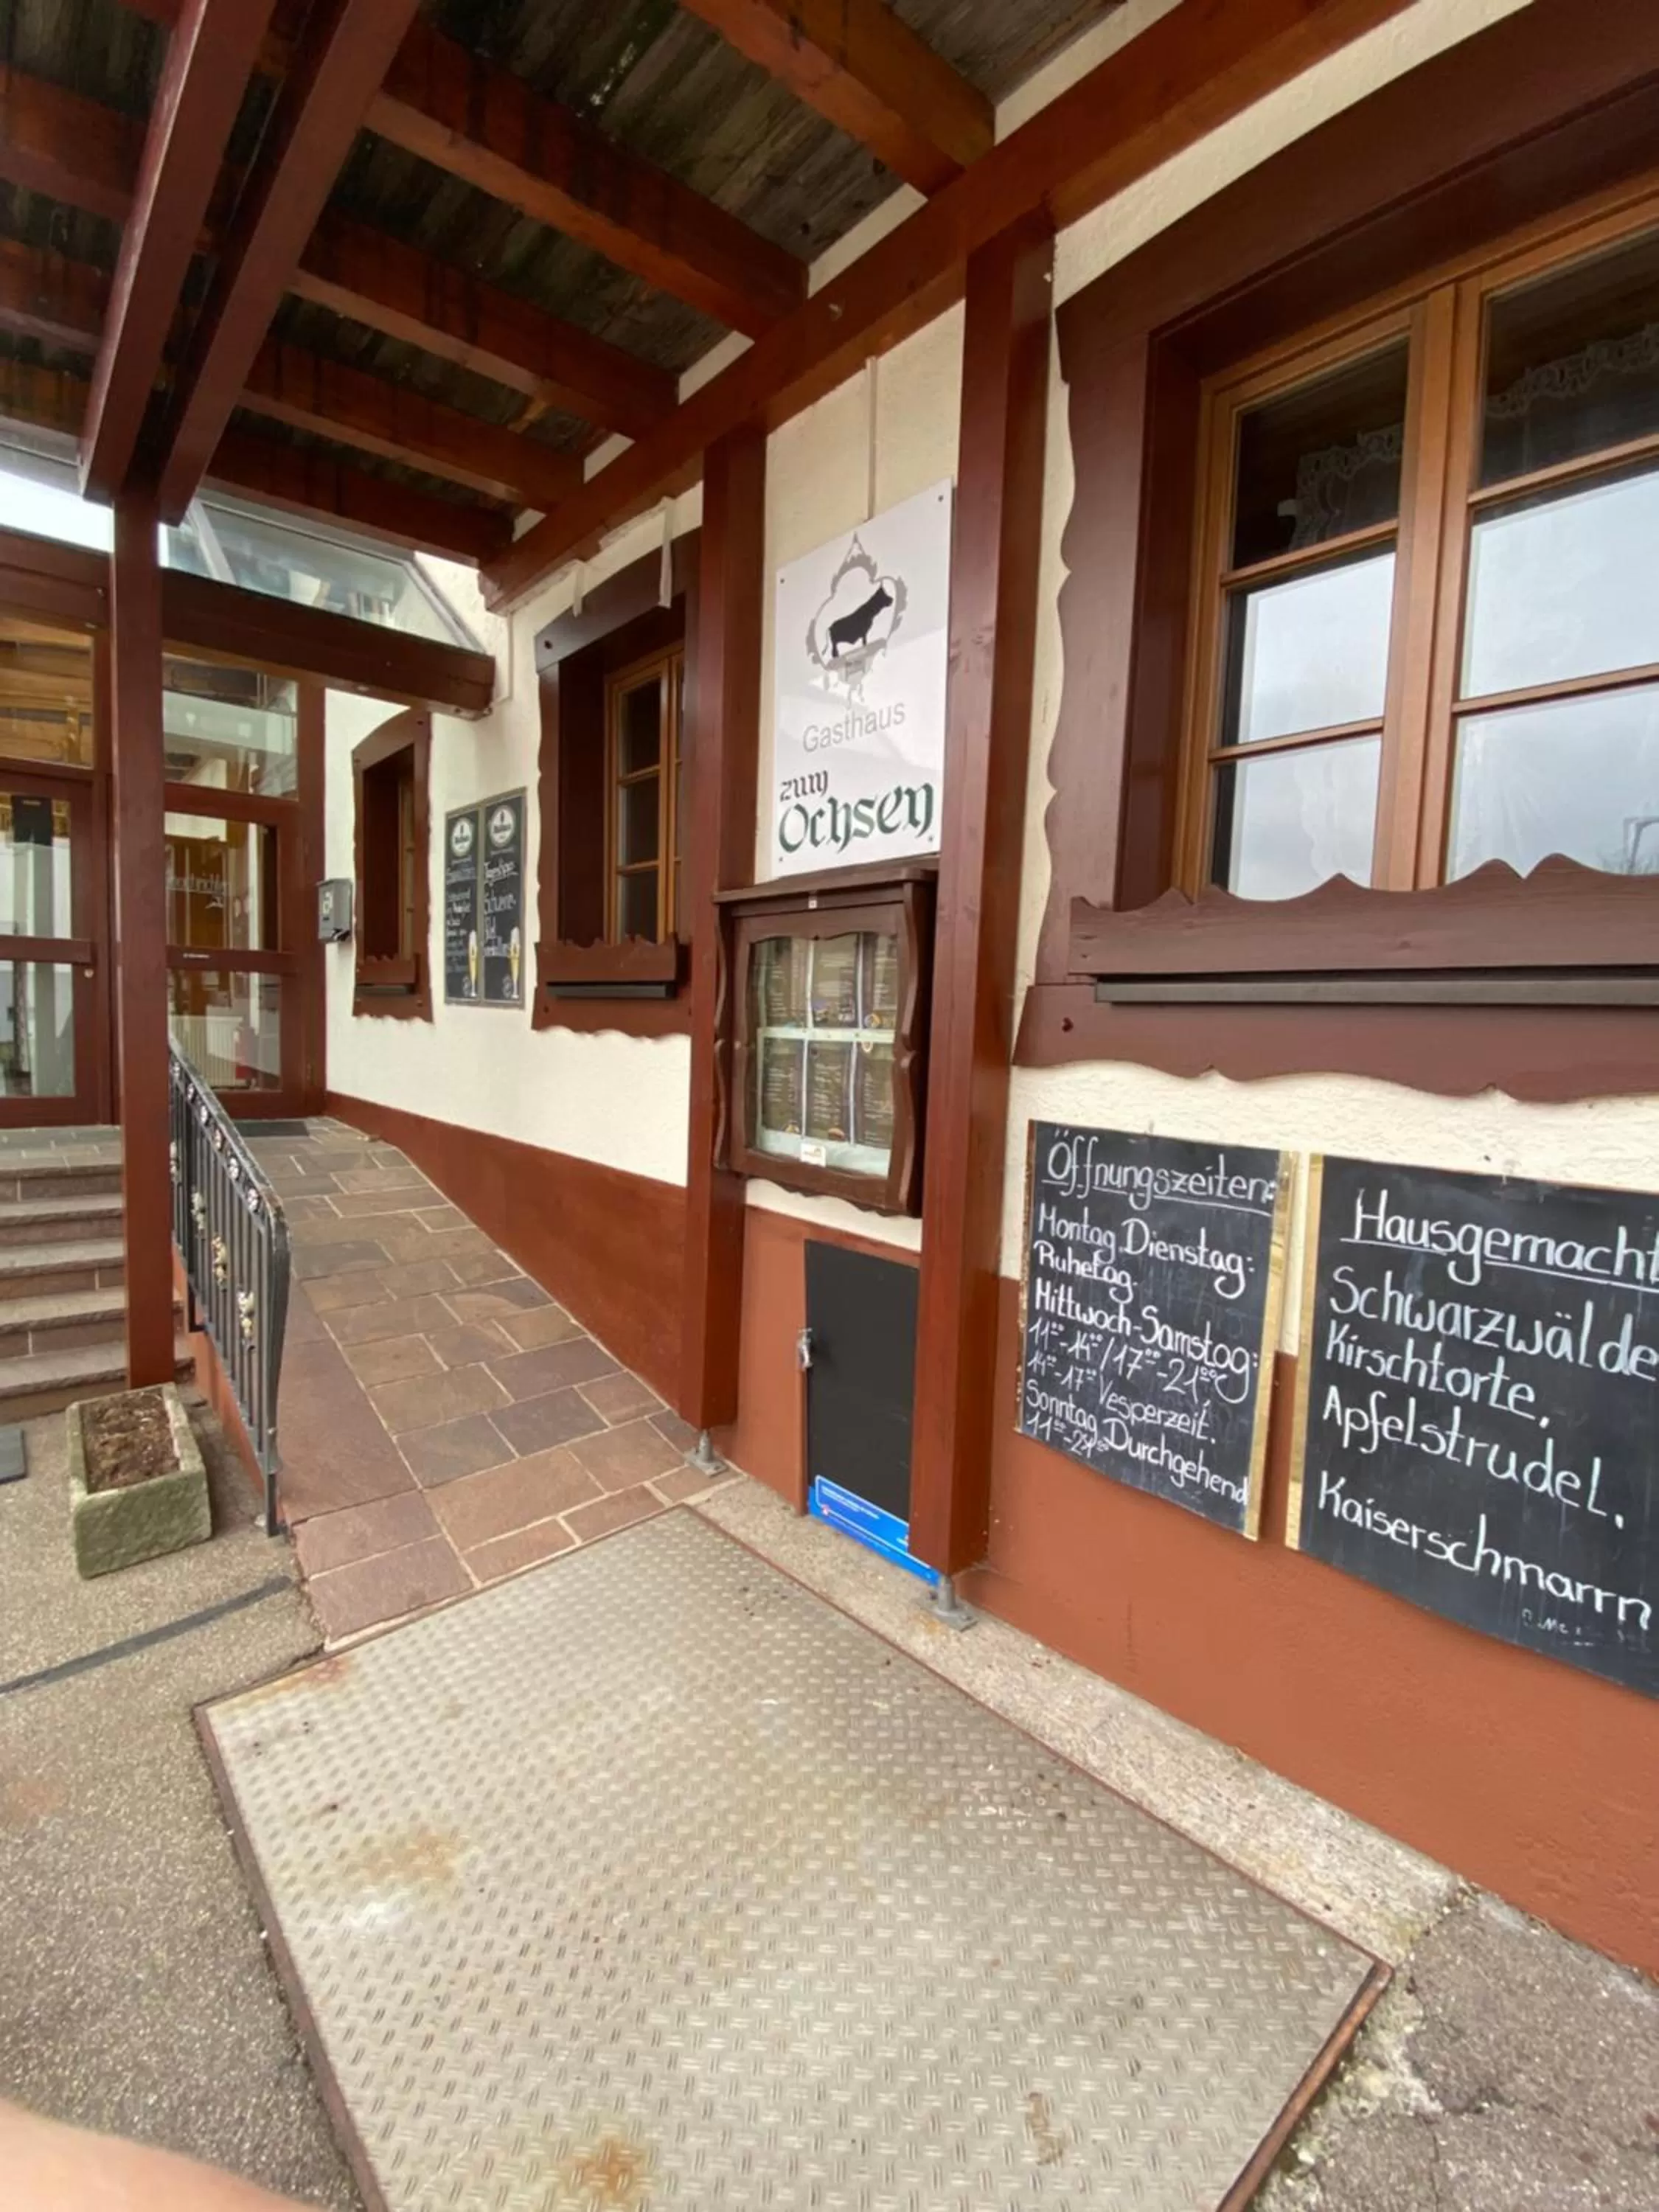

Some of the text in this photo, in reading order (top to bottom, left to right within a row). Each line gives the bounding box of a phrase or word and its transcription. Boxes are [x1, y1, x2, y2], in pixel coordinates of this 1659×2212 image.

[802, 702, 905, 753] Gasthaus
[779, 770, 828, 801] zum
[779, 782, 933, 854] Ochsen
[1330, 1266, 1659, 1382] Schwarzwälde
[1026, 1379, 1248, 1506] Sonntag Durchgehend
[1318, 1470, 1652, 1631] Kaiserschmarrn
